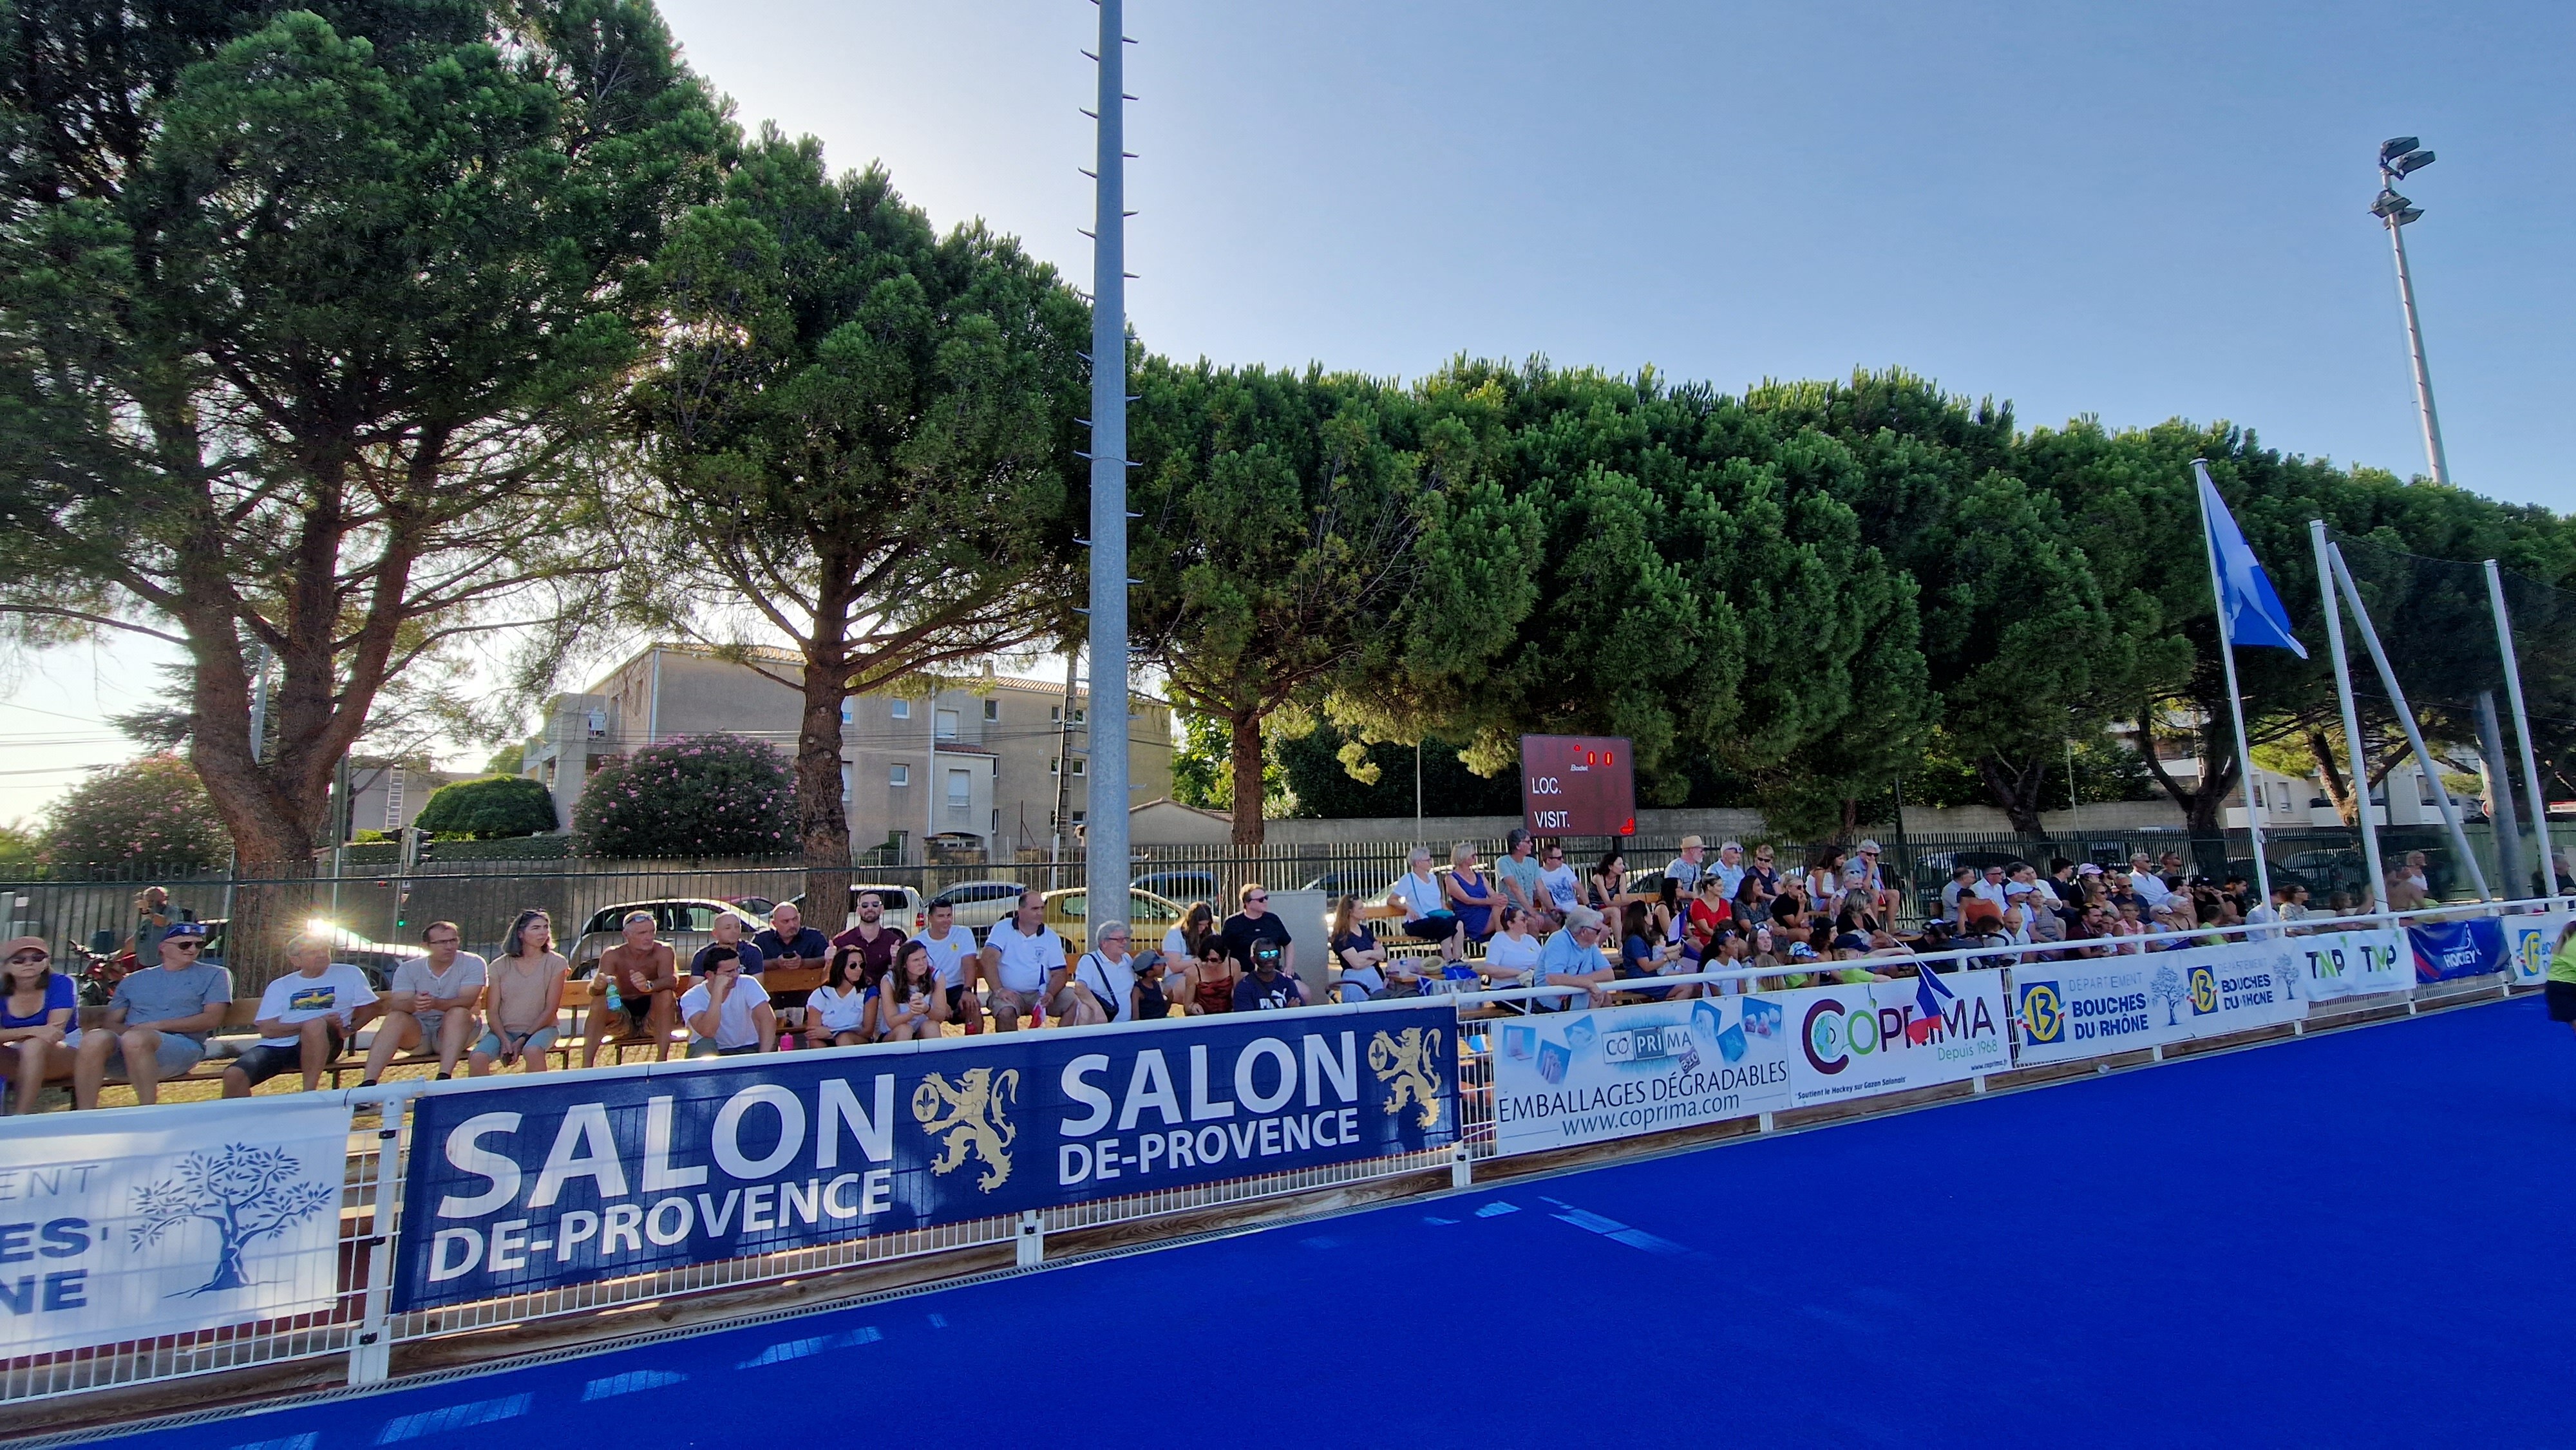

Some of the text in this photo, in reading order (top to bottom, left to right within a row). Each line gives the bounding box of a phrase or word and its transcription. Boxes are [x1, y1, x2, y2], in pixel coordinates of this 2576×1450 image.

[1532, 777, 1562, 795] LOC.
[1534, 811, 1571, 828] VISIT.
[2306, 949, 2345, 979] TNP
[2360, 945, 2396, 972] TNP
[2072, 993, 2146, 1017] BOUCHES
[1606, 1031, 1692, 1055] COPRIMA
[1938, 1039, 1998, 1061] Depuis 1968
[1681, 1051, 1699, 1071] BIO
[1059, 1031, 1357, 1137] SALON
[1499, 1060, 1787, 1123] EMBALLAGES DÉGRADABLES
[1832, 1086, 1853, 1095] Hockey
[1864, 1080, 1881, 1089] Gazon
[1562, 1094, 1739, 1136] www.coprima.com
[437, 1073, 895, 1219] SALON
[1058, 1107, 1360, 1185] DE-PROVENCE
[428, 1168, 892, 1283] DE-PROVENCE
